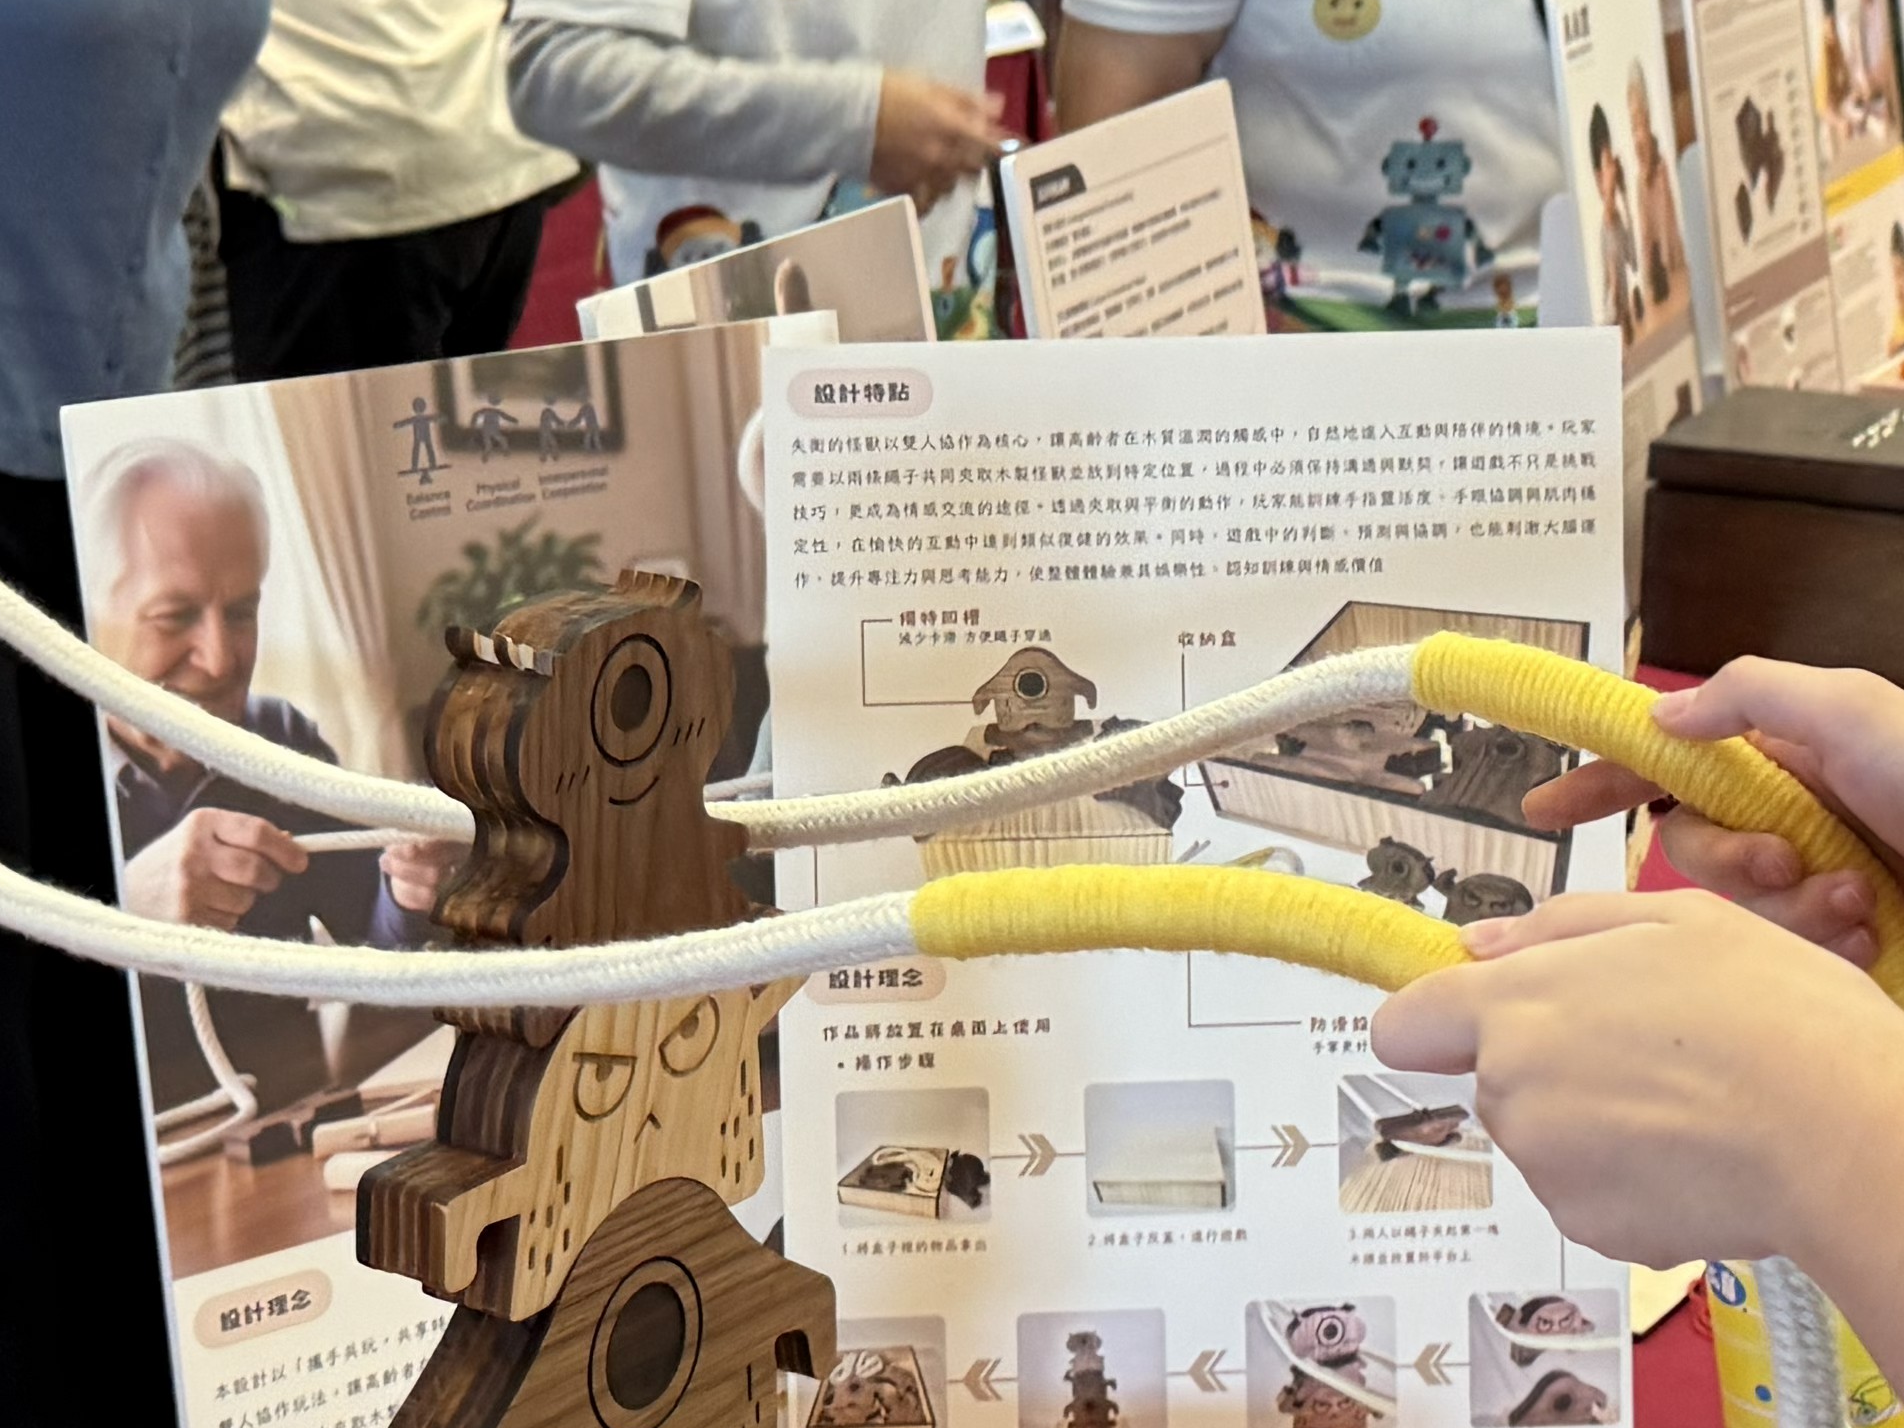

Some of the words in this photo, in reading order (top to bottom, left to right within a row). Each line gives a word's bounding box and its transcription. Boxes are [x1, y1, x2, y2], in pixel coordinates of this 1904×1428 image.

[814, 383, 909, 404] 設計特點
[1178, 630, 1236, 647] 收納盒
[829, 968, 923, 989] 設計理念
[823, 1018, 1051, 1042] 作品將放置在桌面上使用
[855, 1053, 935, 1071] 操作步驟
[220, 1289, 313, 1332] 設計理念
